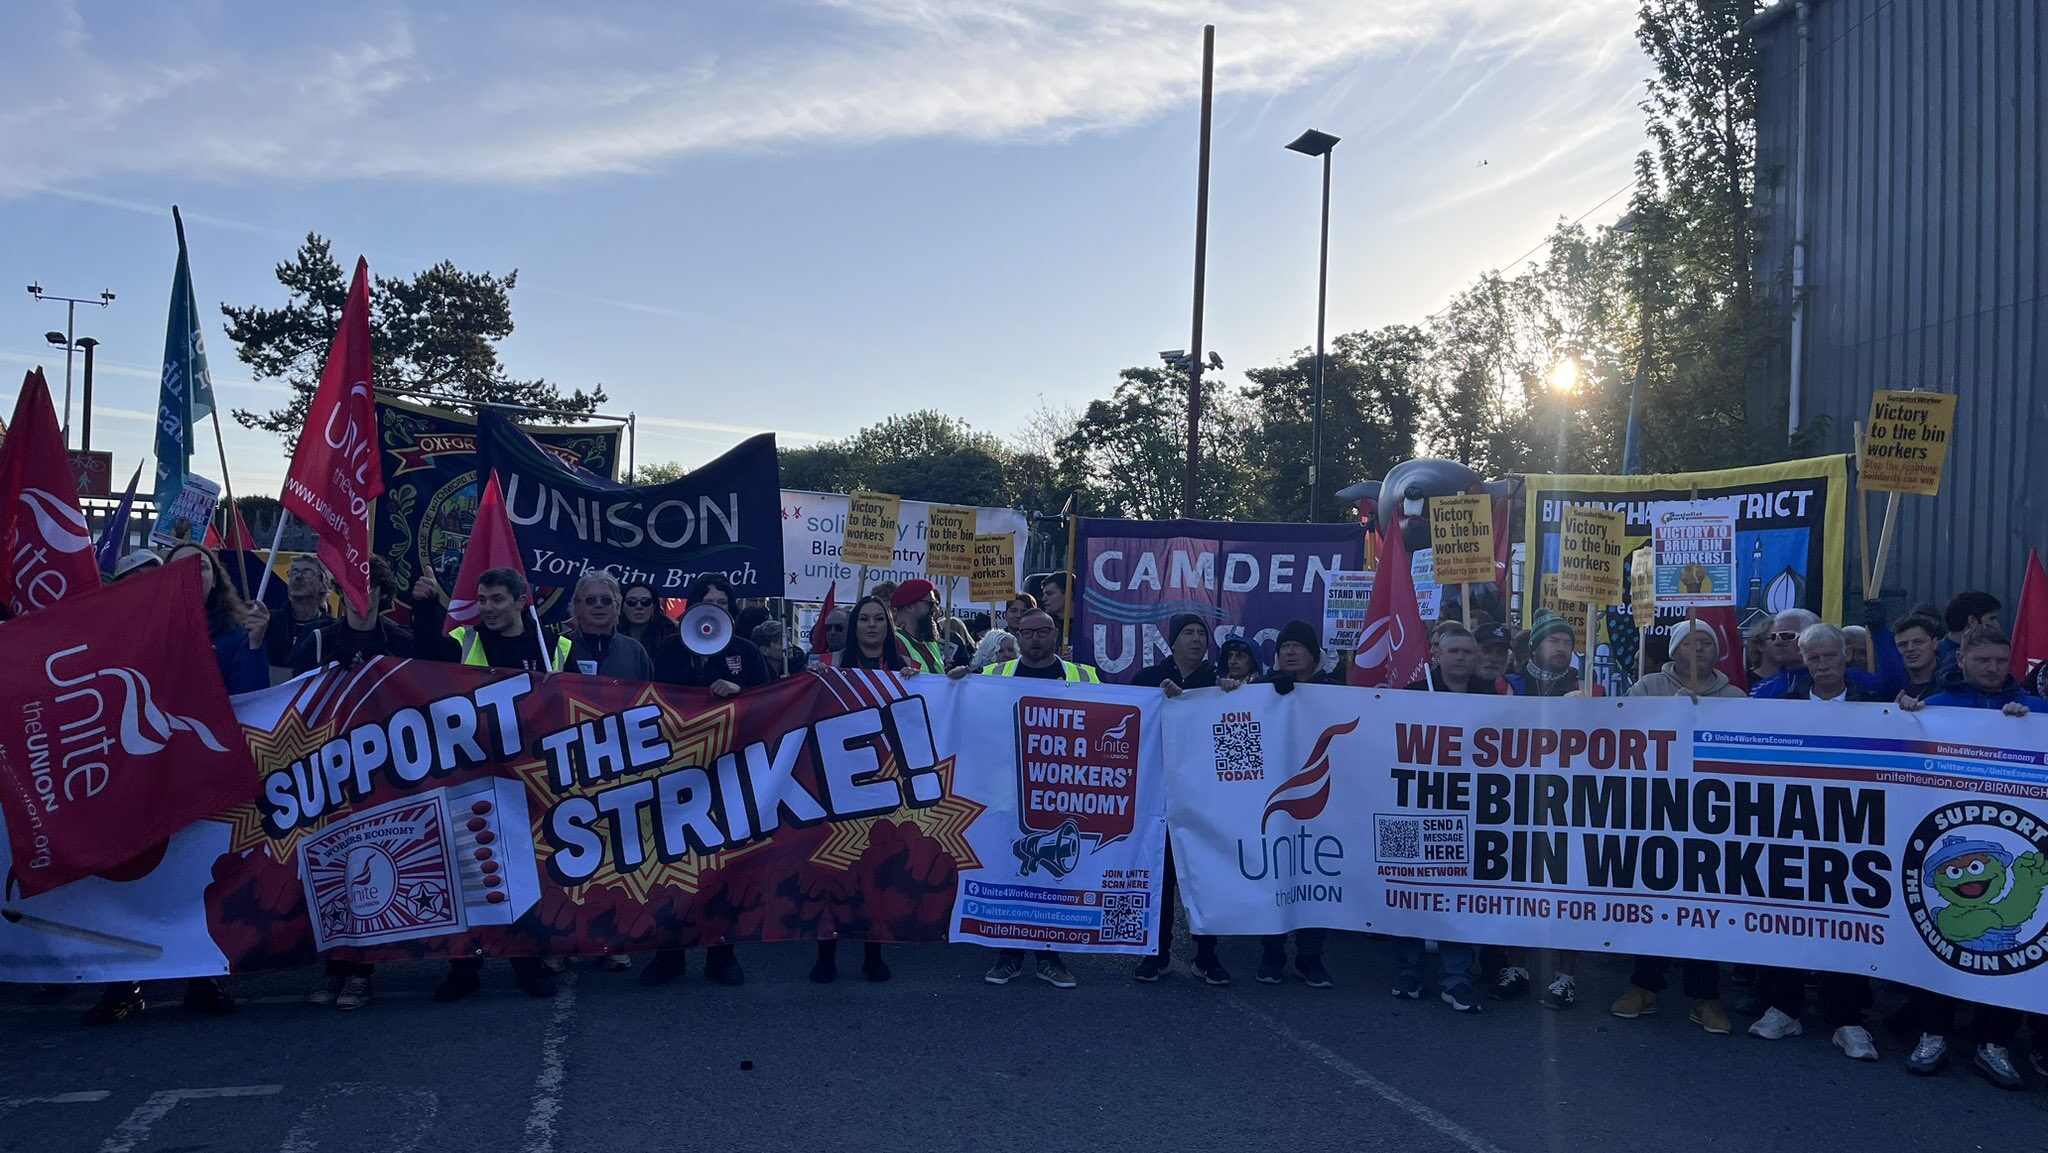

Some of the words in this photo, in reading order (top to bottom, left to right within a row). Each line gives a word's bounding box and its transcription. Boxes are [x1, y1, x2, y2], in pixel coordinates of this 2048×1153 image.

[1875, 403, 1929, 425] Victory
[1871, 422, 1886, 438] to
[1893, 423, 1916, 440] the
[1922, 424, 1945, 442] bin
[421, 436, 477, 452] OXFOR
[1867, 441, 1928, 459] workers
[1862, 470, 1901, 483] Solidarity
[1920, 476, 1934, 485] win
[505, 472, 739, 548] UNISON
[851, 500, 884, 517] Victory
[1433, 507, 1473, 524] Victory
[849, 513, 859, 526] to
[863, 515, 876, 528] the
[881, 516, 895, 529] bin
[930, 514, 963, 529] Victory
[1565, 517, 1607, 540] Victory
[847, 528, 884, 542] workers
[930, 529, 940, 539] to
[943, 529, 957, 540] the
[960, 529, 973, 541] bin
[1434, 524, 1446, 538] to
[1451, 522, 1469, 537] the
[1472, 522, 1489, 536] bin
[1660, 526, 1710, 539] VICTORY
[1713, 525, 1728, 538] TO
[929, 541, 965, 553] workers
[974, 543, 1000, 556] ictory
[1435, 539, 1480, 554] workers
[1564, 536, 1577, 550] to
[1581, 537, 1601, 552] the
[1604, 538, 1621, 556] bin
[1664, 539, 1699, 552] BRUM
[1702, 539, 1723, 551] BIN
[844, 549, 868, 559] Solidarity
[982, 555, 996, 567] the
[999, 554, 1013, 566] bin
[1436, 557, 1451, 566] Stop
[1662, 552, 1725, 564] WORKERS!
[531, 549, 594, 578] York
[805, 562, 851, 580] unite
[928, 561, 951, 570] Solidarity
[1563, 555, 1610, 572] workers
[1093, 550, 1342, 593] CAMDEN
[1436, 567, 1467, 576] Solidarity
[1562, 571, 1579, 584] Stop
[1581, 571, 1591, 582] the
[1592, 573, 1620, 586] scabbing
[1329, 589, 1354, 599] STAND
[1356, 589, 1372, 599] WIT
[1560, 582, 1594, 595] Solidarity
[1595, 587, 1606, 595] can
[1327, 599, 1370, 609] BIRMINGHA
[1558, 597, 1579, 612] the
[1327, 609, 1341, 618] BIN
[1336, 620, 1345, 628] IN
[1347, 620, 1364, 628] UNIT
[1328, 638, 1354, 646] COUNCIL
[1336, 631, 1354, 639] FIGHT
[45, 643, 115, 801] unite
[1024, 705, 1086, 730] UNITE
[1221, 712, 1251, 723] JOIN
[541, 704, 669, 788] THE
[1028, 734, 1067, 757] FOR
[1074, 737, 1087, 758] A
[1095, 740, 1129, 753] unite
[1395, 722, 1463, 767] WE
[1472, 727, 1677, 771] SUPPORT
[1715, 733, 1804, 747] Unite4WorkersEconomy
[263, 672, 536, 831] SUPPORT
[1937, 745, 2036, 763] Unite4WorkersEconomy
[1216, 769, 1264, 782] TODAY!
[552, 697, 942, 880] STRIKE!
[1030, 790, 1129, 815] ECONOMY
[1390, 768, 1471, 811] THE
[1476, 773, 1886, 846] BIRMINGHAM
[1423, 819, 1453, 830] SEND
[1456, 819, 1464, 830] A
[1934, 805, 2048, 843] SUPPORT
[365, 826, 415, 840] ECONOMY
[1423, 833, 1464, 842] MESSAGE
[1237, 825, 1344, 881] unite
[1425, 845, 1465, 860] HERE
[1102, 869, 1123, 878] JOIN
[1126, 870, 1149, 879] UNITE
[1377, 866, 1415, 877] ACTION
[1417, 867, 1468, 877] NETWORK
[1473, 830, 1568, 885] BIN
[1583, 833, 1892, 909] WORKERS
[1101, 880, 1125, 889] SCAN
[1126, 881, 1149, 889] HERE
[981, 886, 1080, 903] Unite4WorkersEconomy
[980, 905, 1093, 923] Twitter.com/UniteEconomy
[1385, 889, 1451, 912] UNITE:
[1457, 894, 1551, 918] FIGHTING
[1557, 900, 1597, 921] FOR
[1602, 904, 1654, 925] JOBS
[1676, 906, 1720, 930] PAY
[1744, 912, 1885, 946] CONDITIONS
[1906, 868, 1920, 904] THE
[1914, 908, 1955, 960] BRUM
[1959, 951, 1999, 971] BIN
[979, 923, 1091, 944] unitetheunion.org
